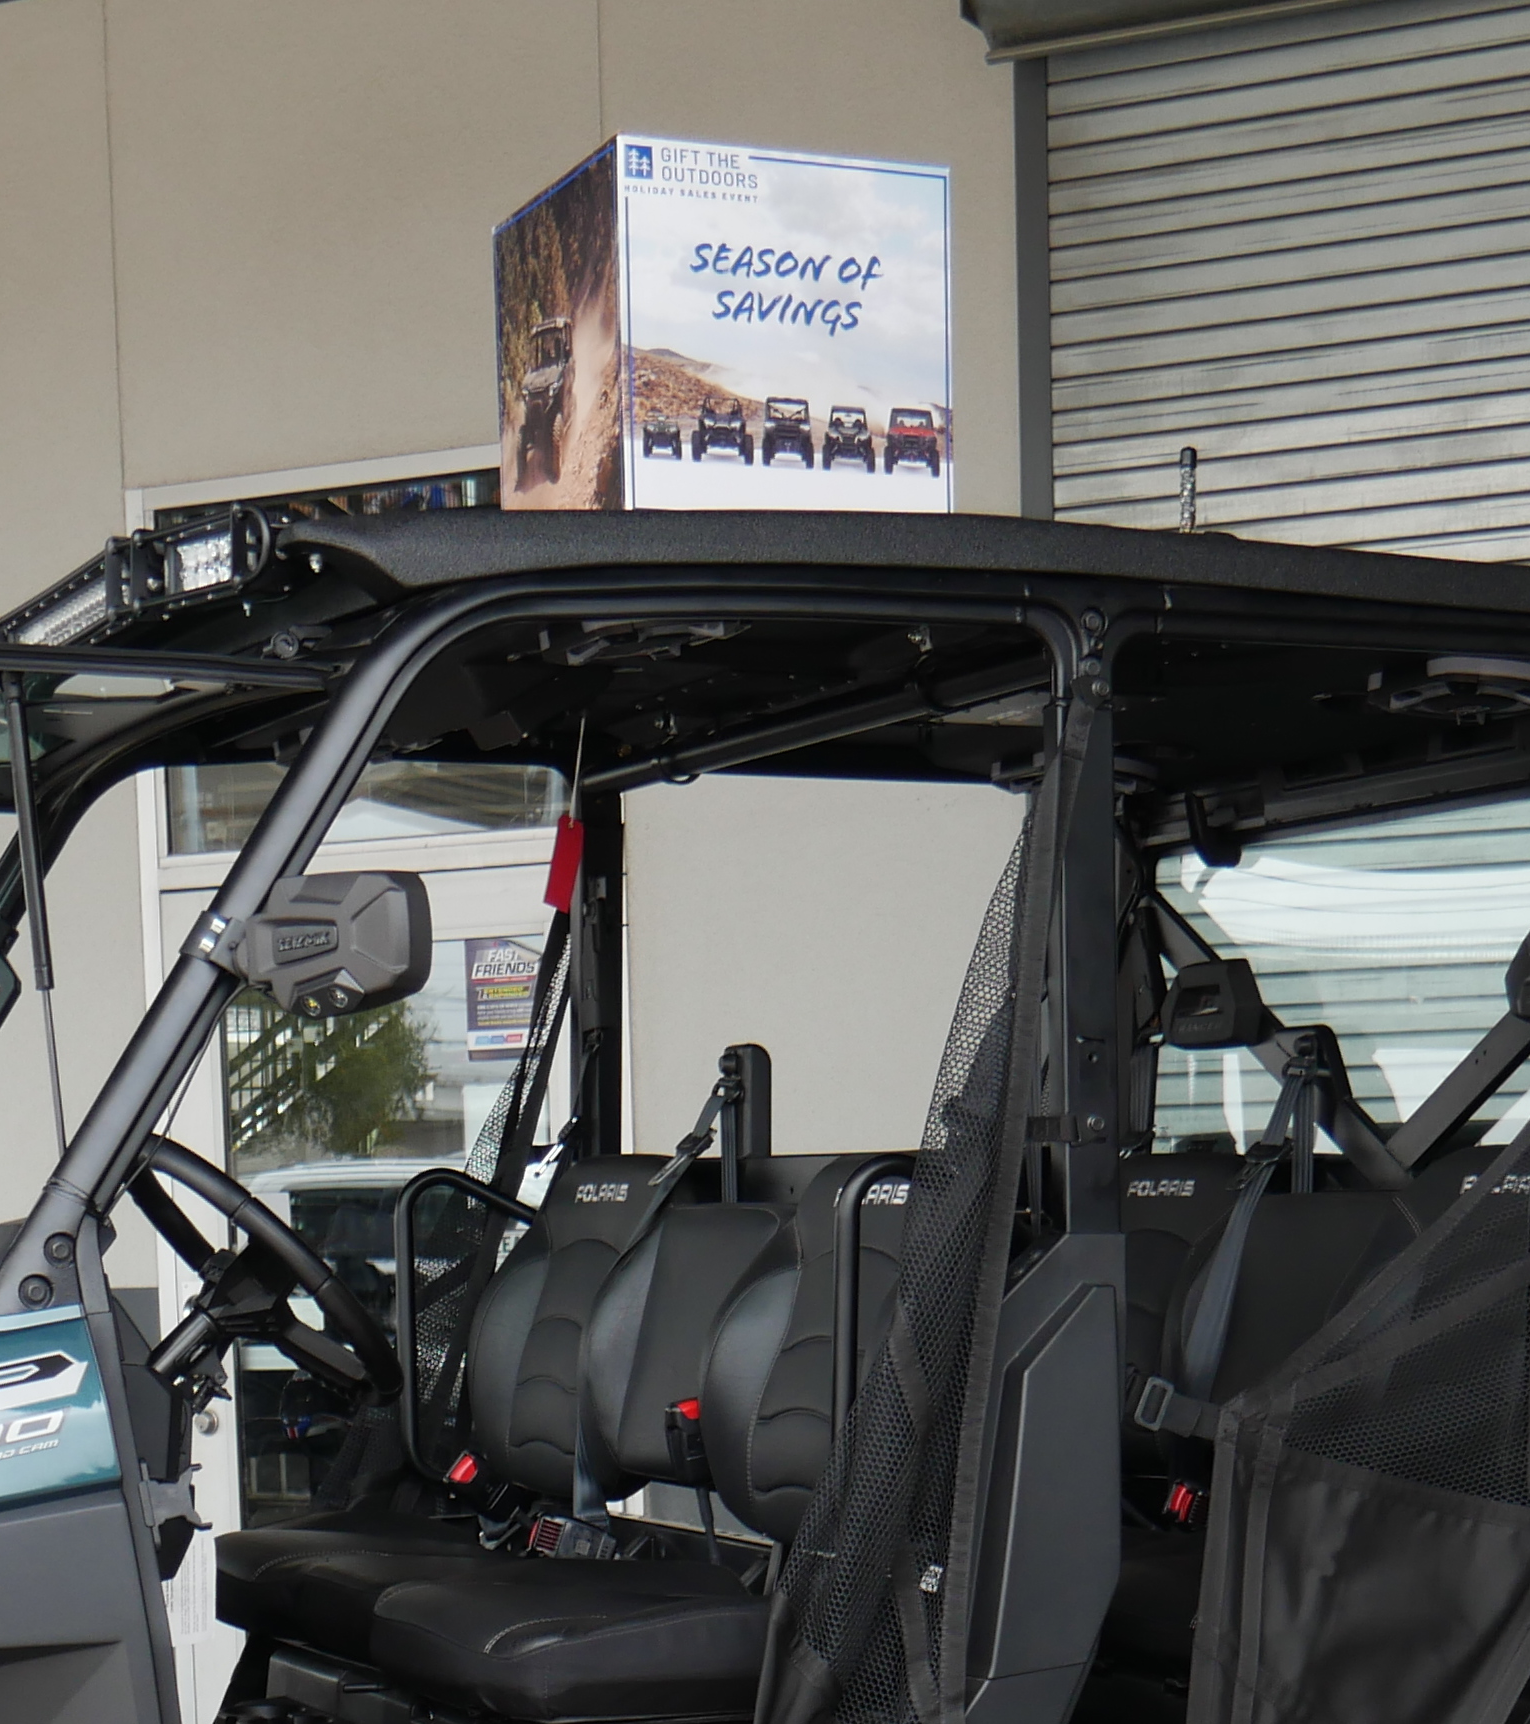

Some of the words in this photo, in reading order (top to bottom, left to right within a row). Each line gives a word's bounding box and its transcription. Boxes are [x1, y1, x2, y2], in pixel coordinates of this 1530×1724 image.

[660, 147, 701, 166] GIFT
[706, 151, 740, 170] THE
[661, 165, 758, 190] OUTDOORS
[624, 185, 674, 196] HOLIDAY
[679, 189, 717, 200] SALES
[721, 192, 758, 203] EVENT
[689, 242, 833, 282] SEASON
[837, 255, 884, 291] OF
[712, 289, 863, 337] SAVINGS
[474, 961, 536, 978] FRIENDS
[575, 1183, 630, 1204] POLARIS
[1127, 1178, 1196, 1198] POLARIS
[19, 1438, 60, 1459] CAM
